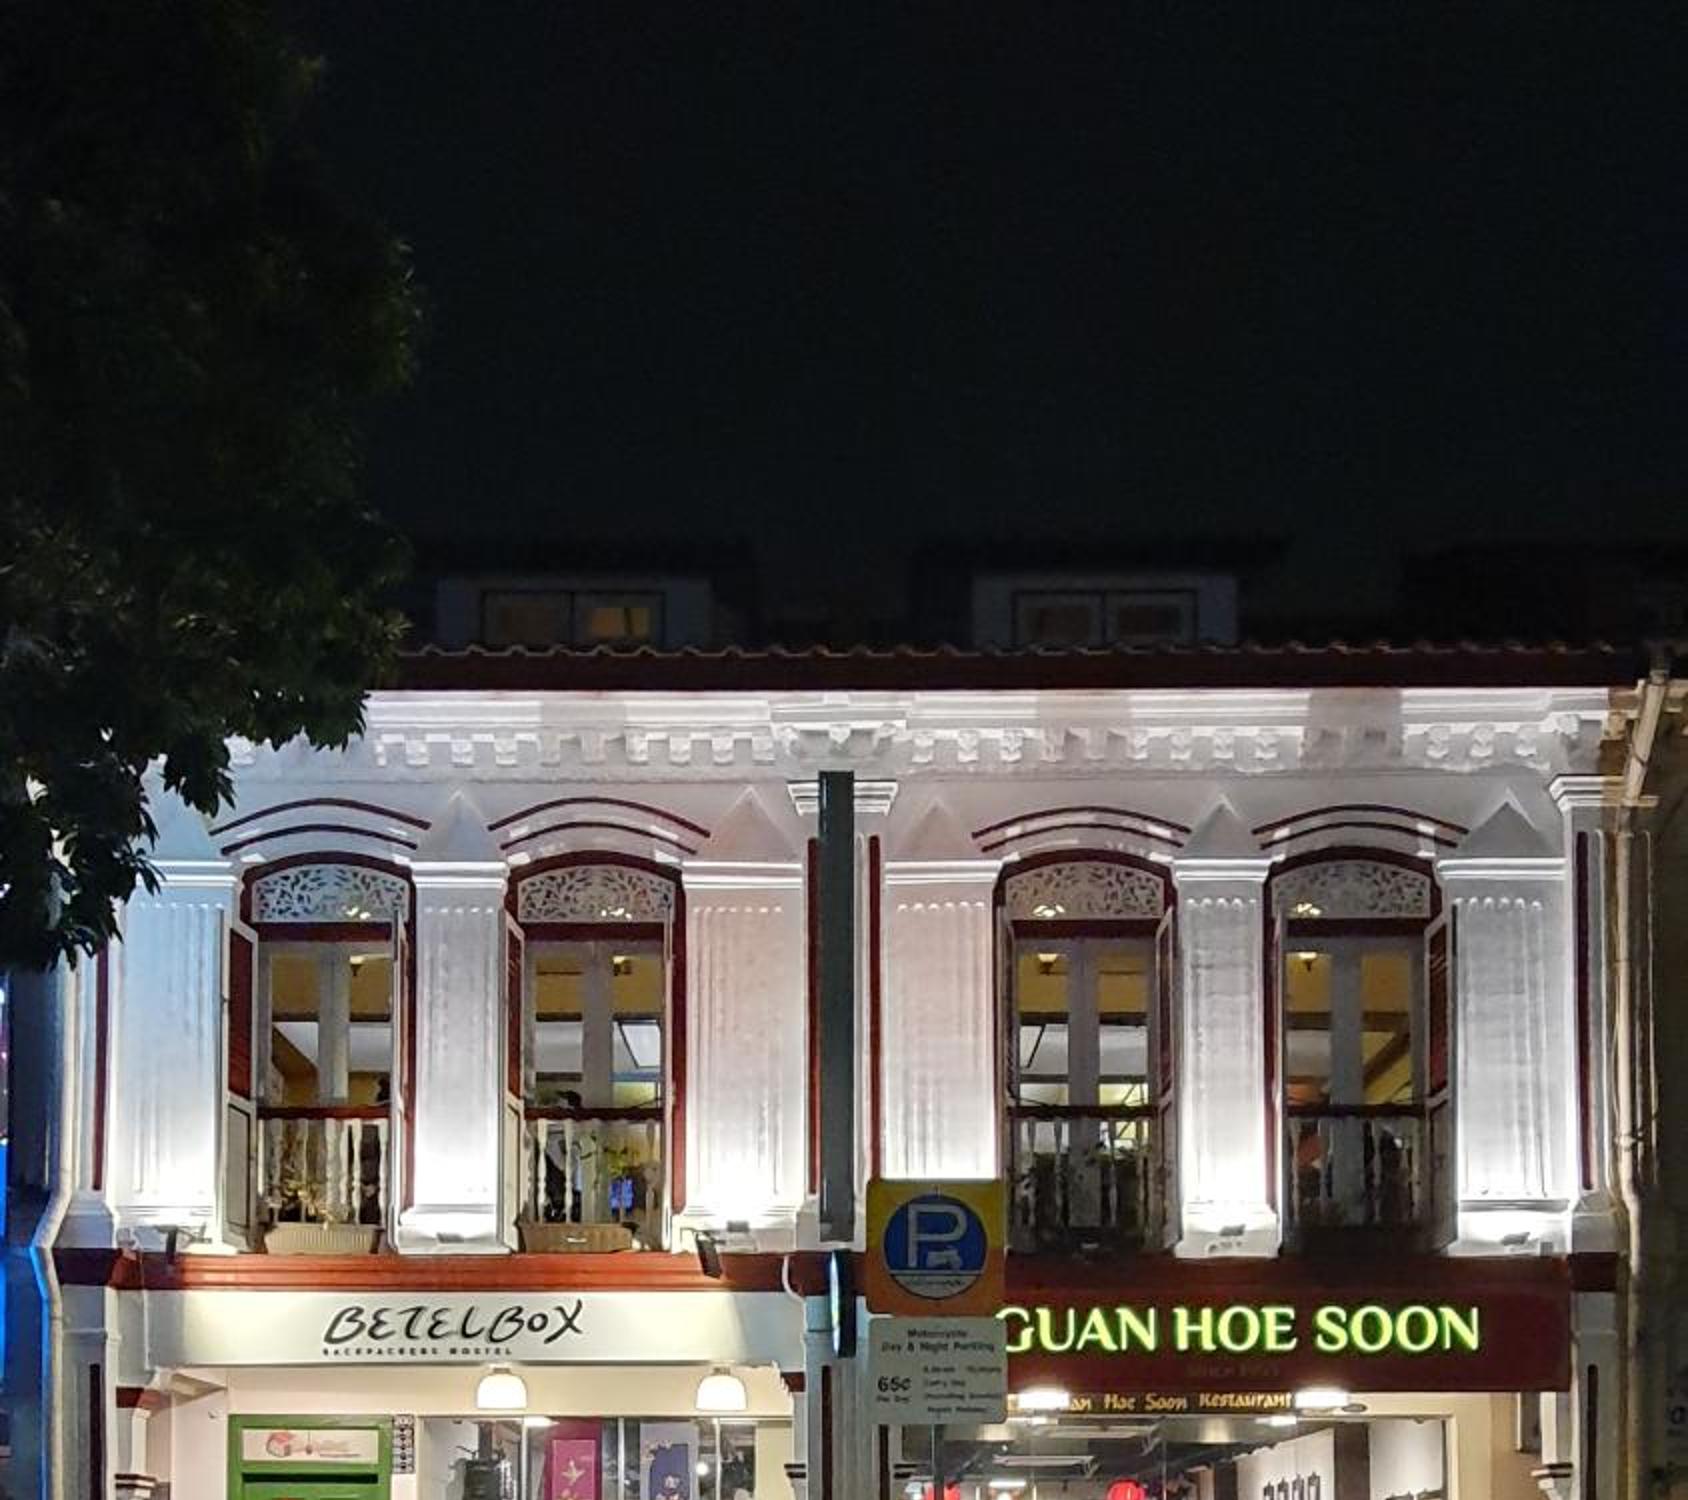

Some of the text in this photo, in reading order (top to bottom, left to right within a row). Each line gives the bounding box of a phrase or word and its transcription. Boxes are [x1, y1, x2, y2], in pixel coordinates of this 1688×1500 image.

[907, 1203, 967, 1268] P
[996, 1306, 1480, 1352] GUAN HOE SOON
[1145, 1393, 1189, 1411] Soon
[1199, 1391, 1293, 1409] Restaurant
